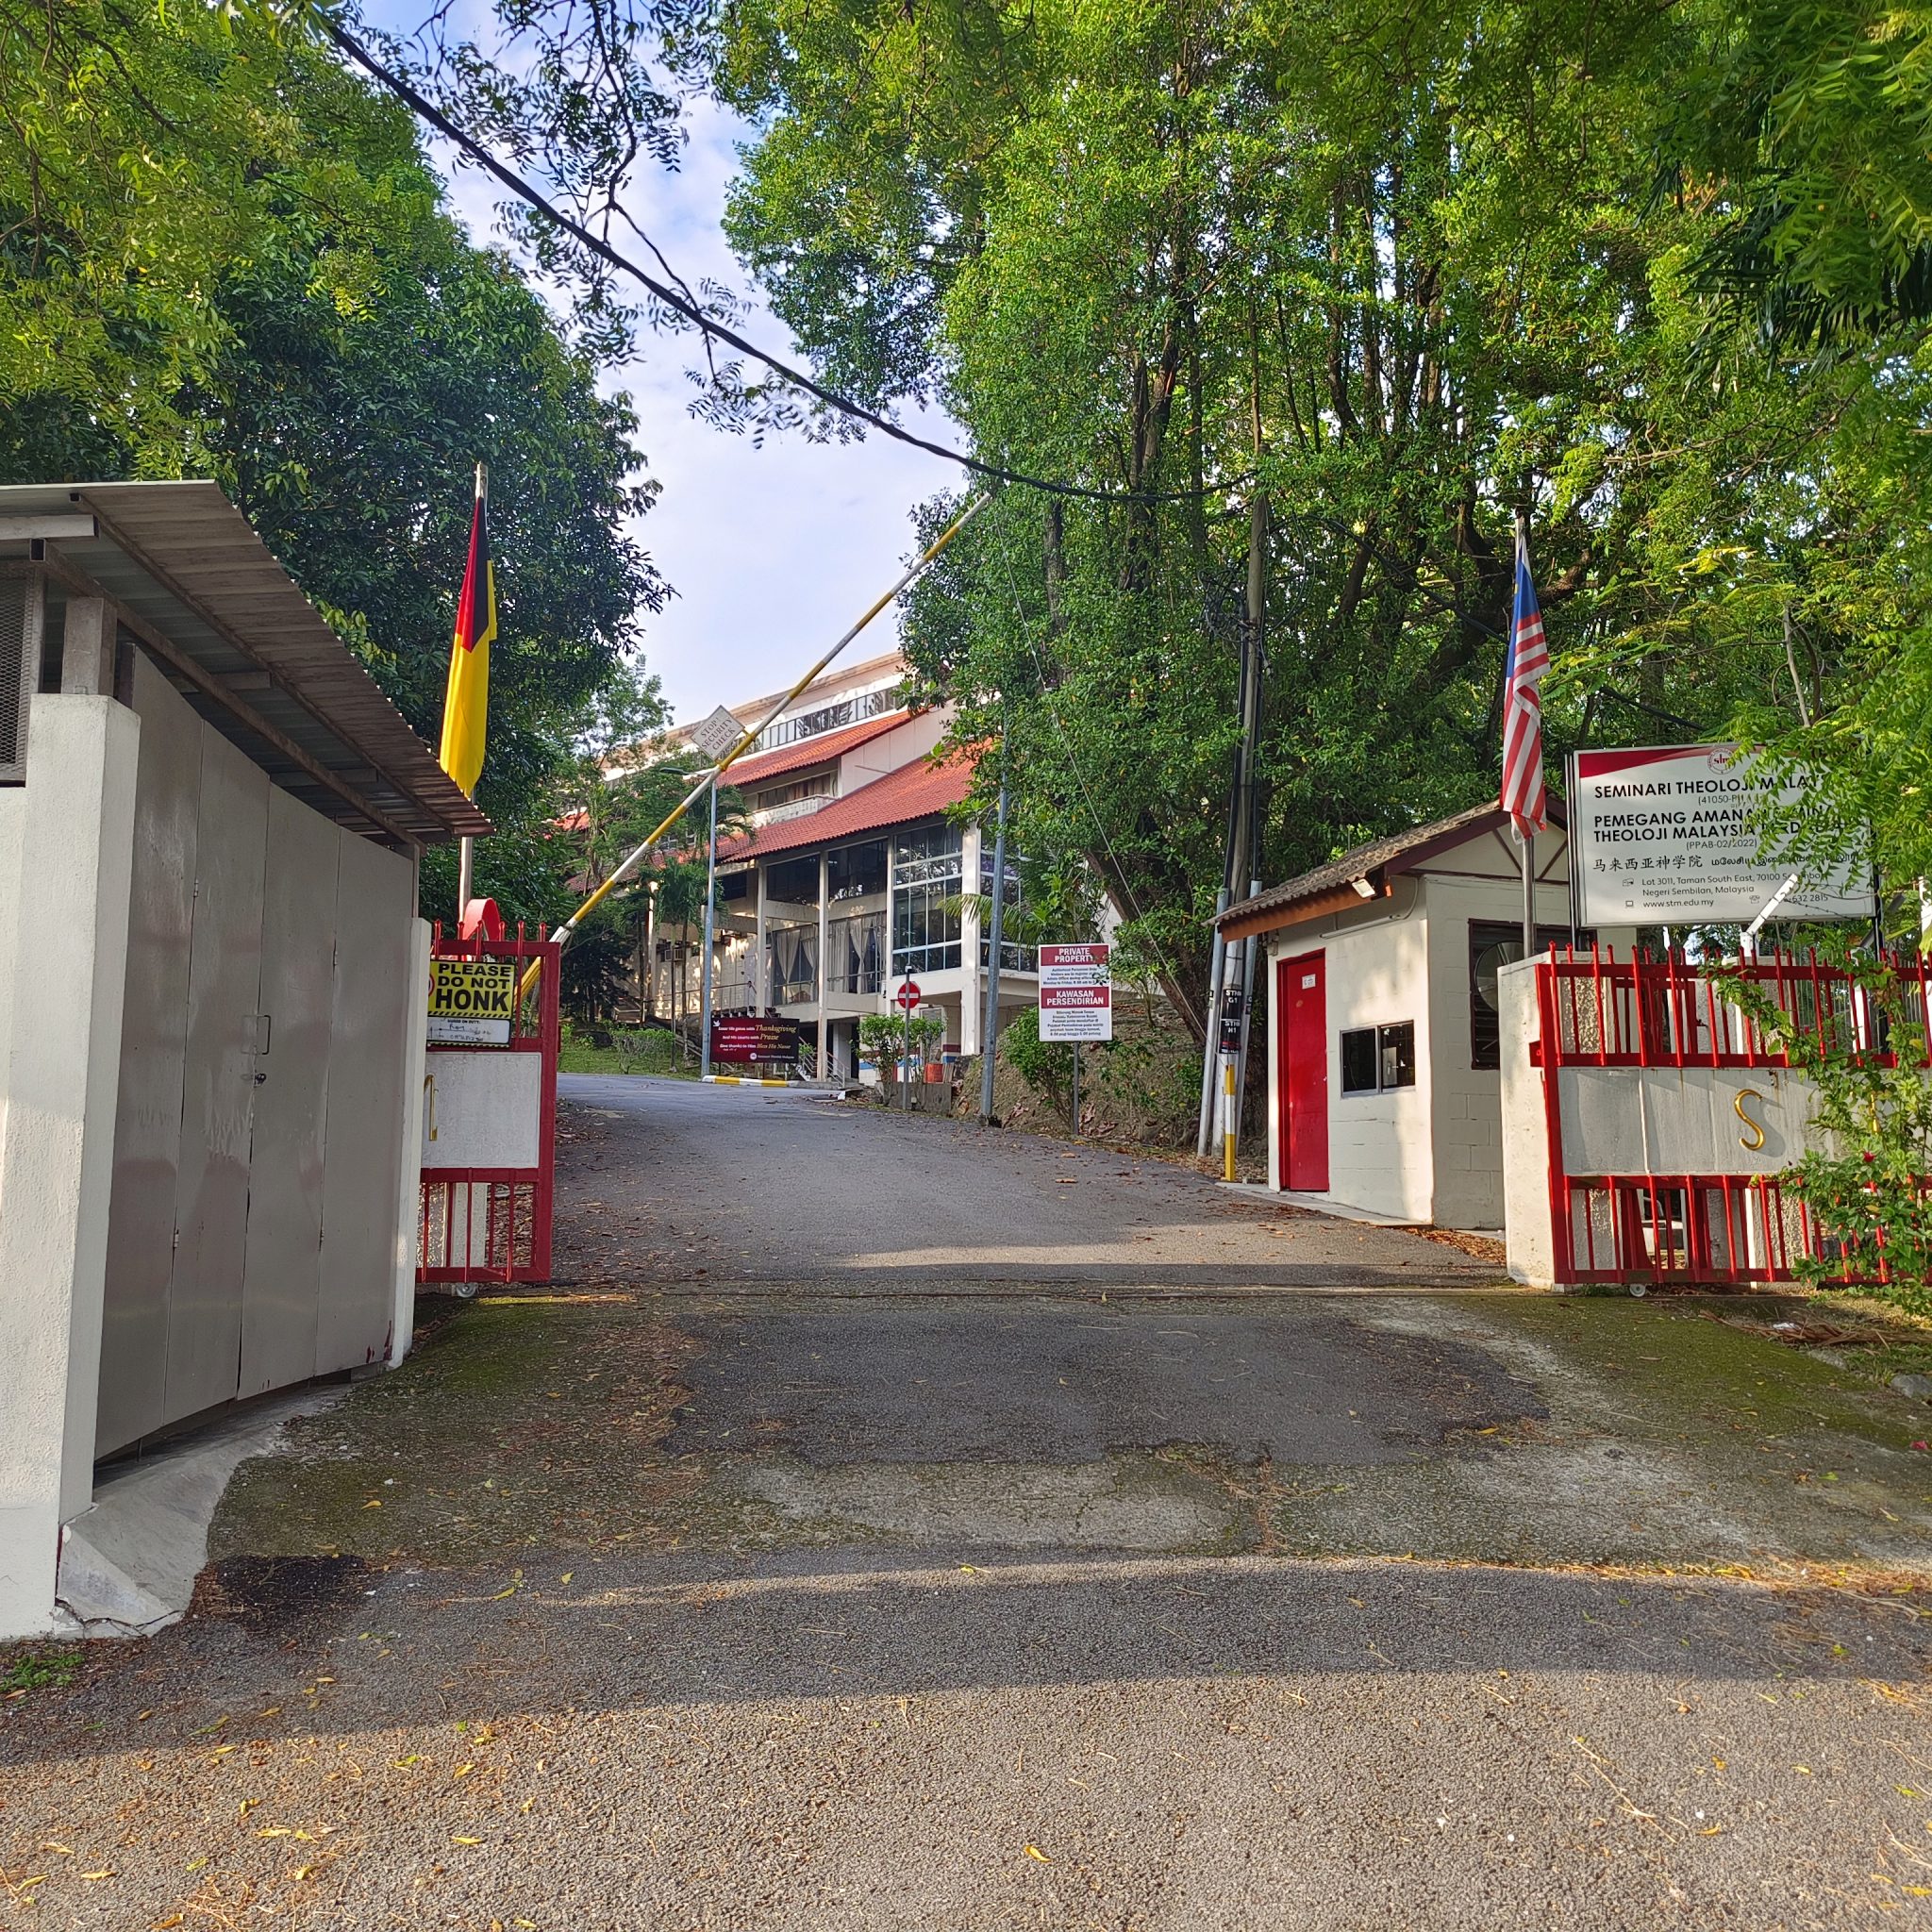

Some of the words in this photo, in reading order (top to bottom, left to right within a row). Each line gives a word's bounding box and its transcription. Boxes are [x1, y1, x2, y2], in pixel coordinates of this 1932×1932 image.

[1594, 782, 1672, 799] SEMINARI
[1594, 811, 1687, 828] PEMEGANG
[1593, 827, 1668, 842] THEOLOJI
[1673, 824, 1756, 840] MALAYSIA
[1592, 855, 1704, 873] 马来西亚神学院
[1641, 877, 1655, 886] Lot
[1677, 876, 1706, 885] Taman
[1707, 875, 1732, 884] South
[1757, 873, 1780, 881] 70100
[1642, 889, 1670, 897] Negeri
[1716, 885, 1755, 894] Malaysia
[1058, 947, 1091, 956] PRIVATE
[1055, 955, 1093, 963] PROPERTY
[438, 963, 511, 977] PLEASE
[438, 976, 464, 987] DO
[471, 977, 510, 990] NOT
[435, 988, 509, 1012] HONK
[1056, 990, 1094, 998] KAWASAN
[1046, 997, 1104, 1007] PERSENDIRIAN
